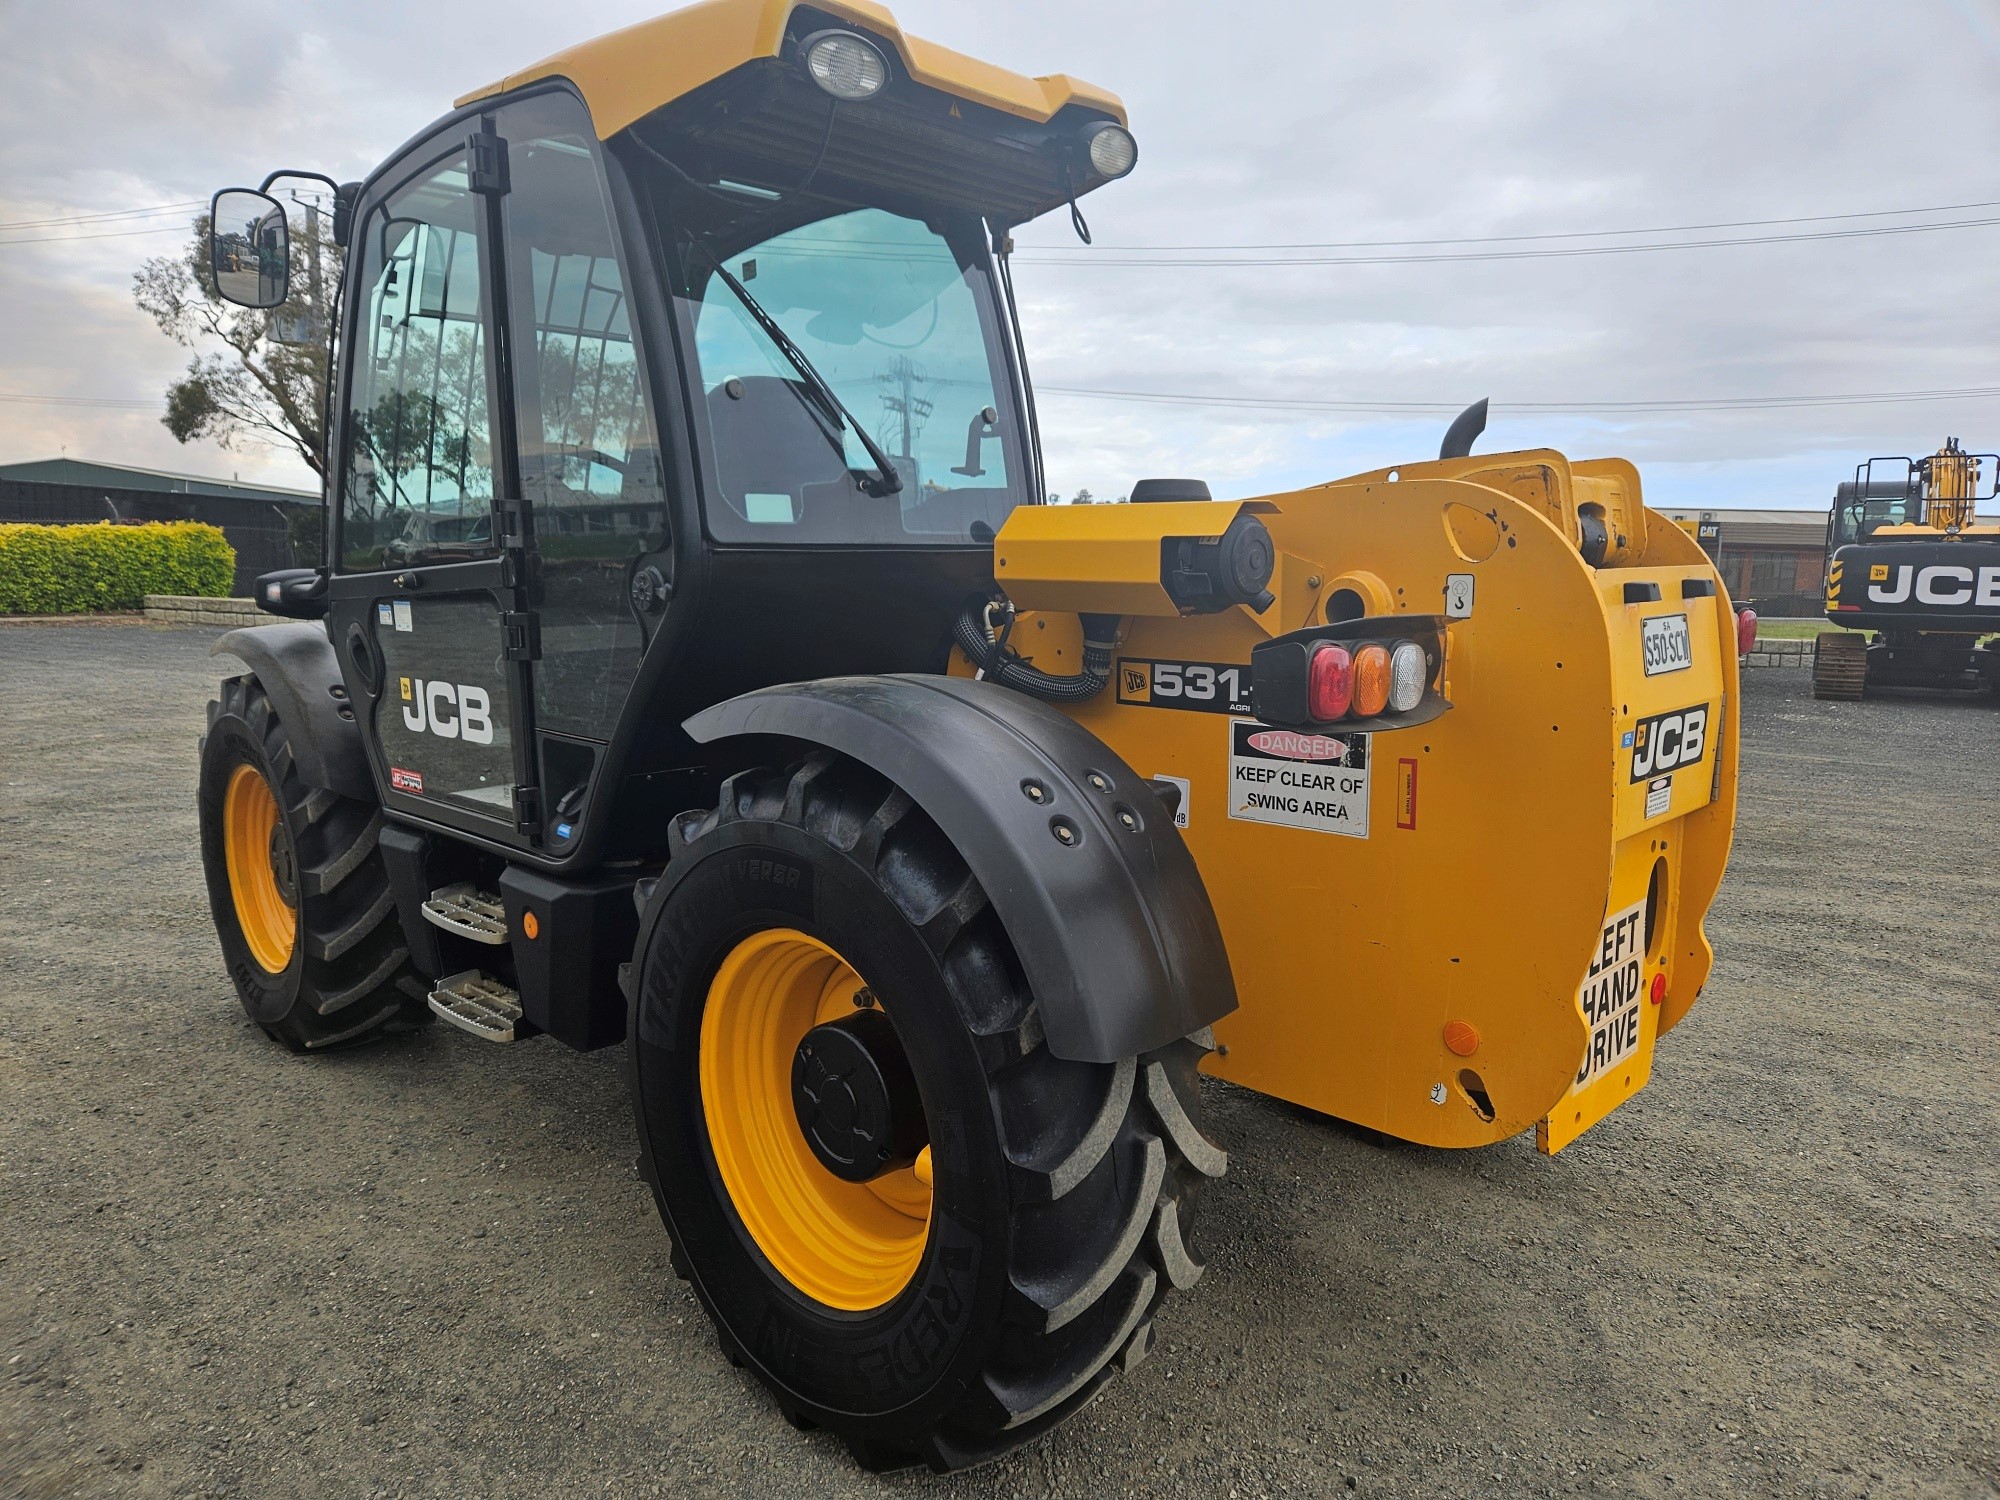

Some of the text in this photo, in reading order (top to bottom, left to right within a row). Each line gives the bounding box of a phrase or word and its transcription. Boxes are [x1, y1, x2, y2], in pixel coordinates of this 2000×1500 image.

[1700, 526, 1719, 537] CAT
[1663, 621, 1671, 631] SA
[1127, 672, 1146, 691] JCB
[1153, 663, 1253, 702] 531-
[402, 678, 494, 745] JCB
[1229, 703, 1251, 712] AGRI
[1258, 733, 1339, 757] DANGER
[1633, 709, 1706, 777] JCB
[1235, 765, 1364, 794] KEEP CLEAR OF
[1176, 812, 1186, 824] dB
[1247, 792, 1349, 820] SWING AREA
[737, 859, 801, 889] VERSA
[1589, 910, 1640, 979] LEFT
[1583, 959, 1639, 1027] HAND
[1577, 1004, 1639, 1085] DRIVE
